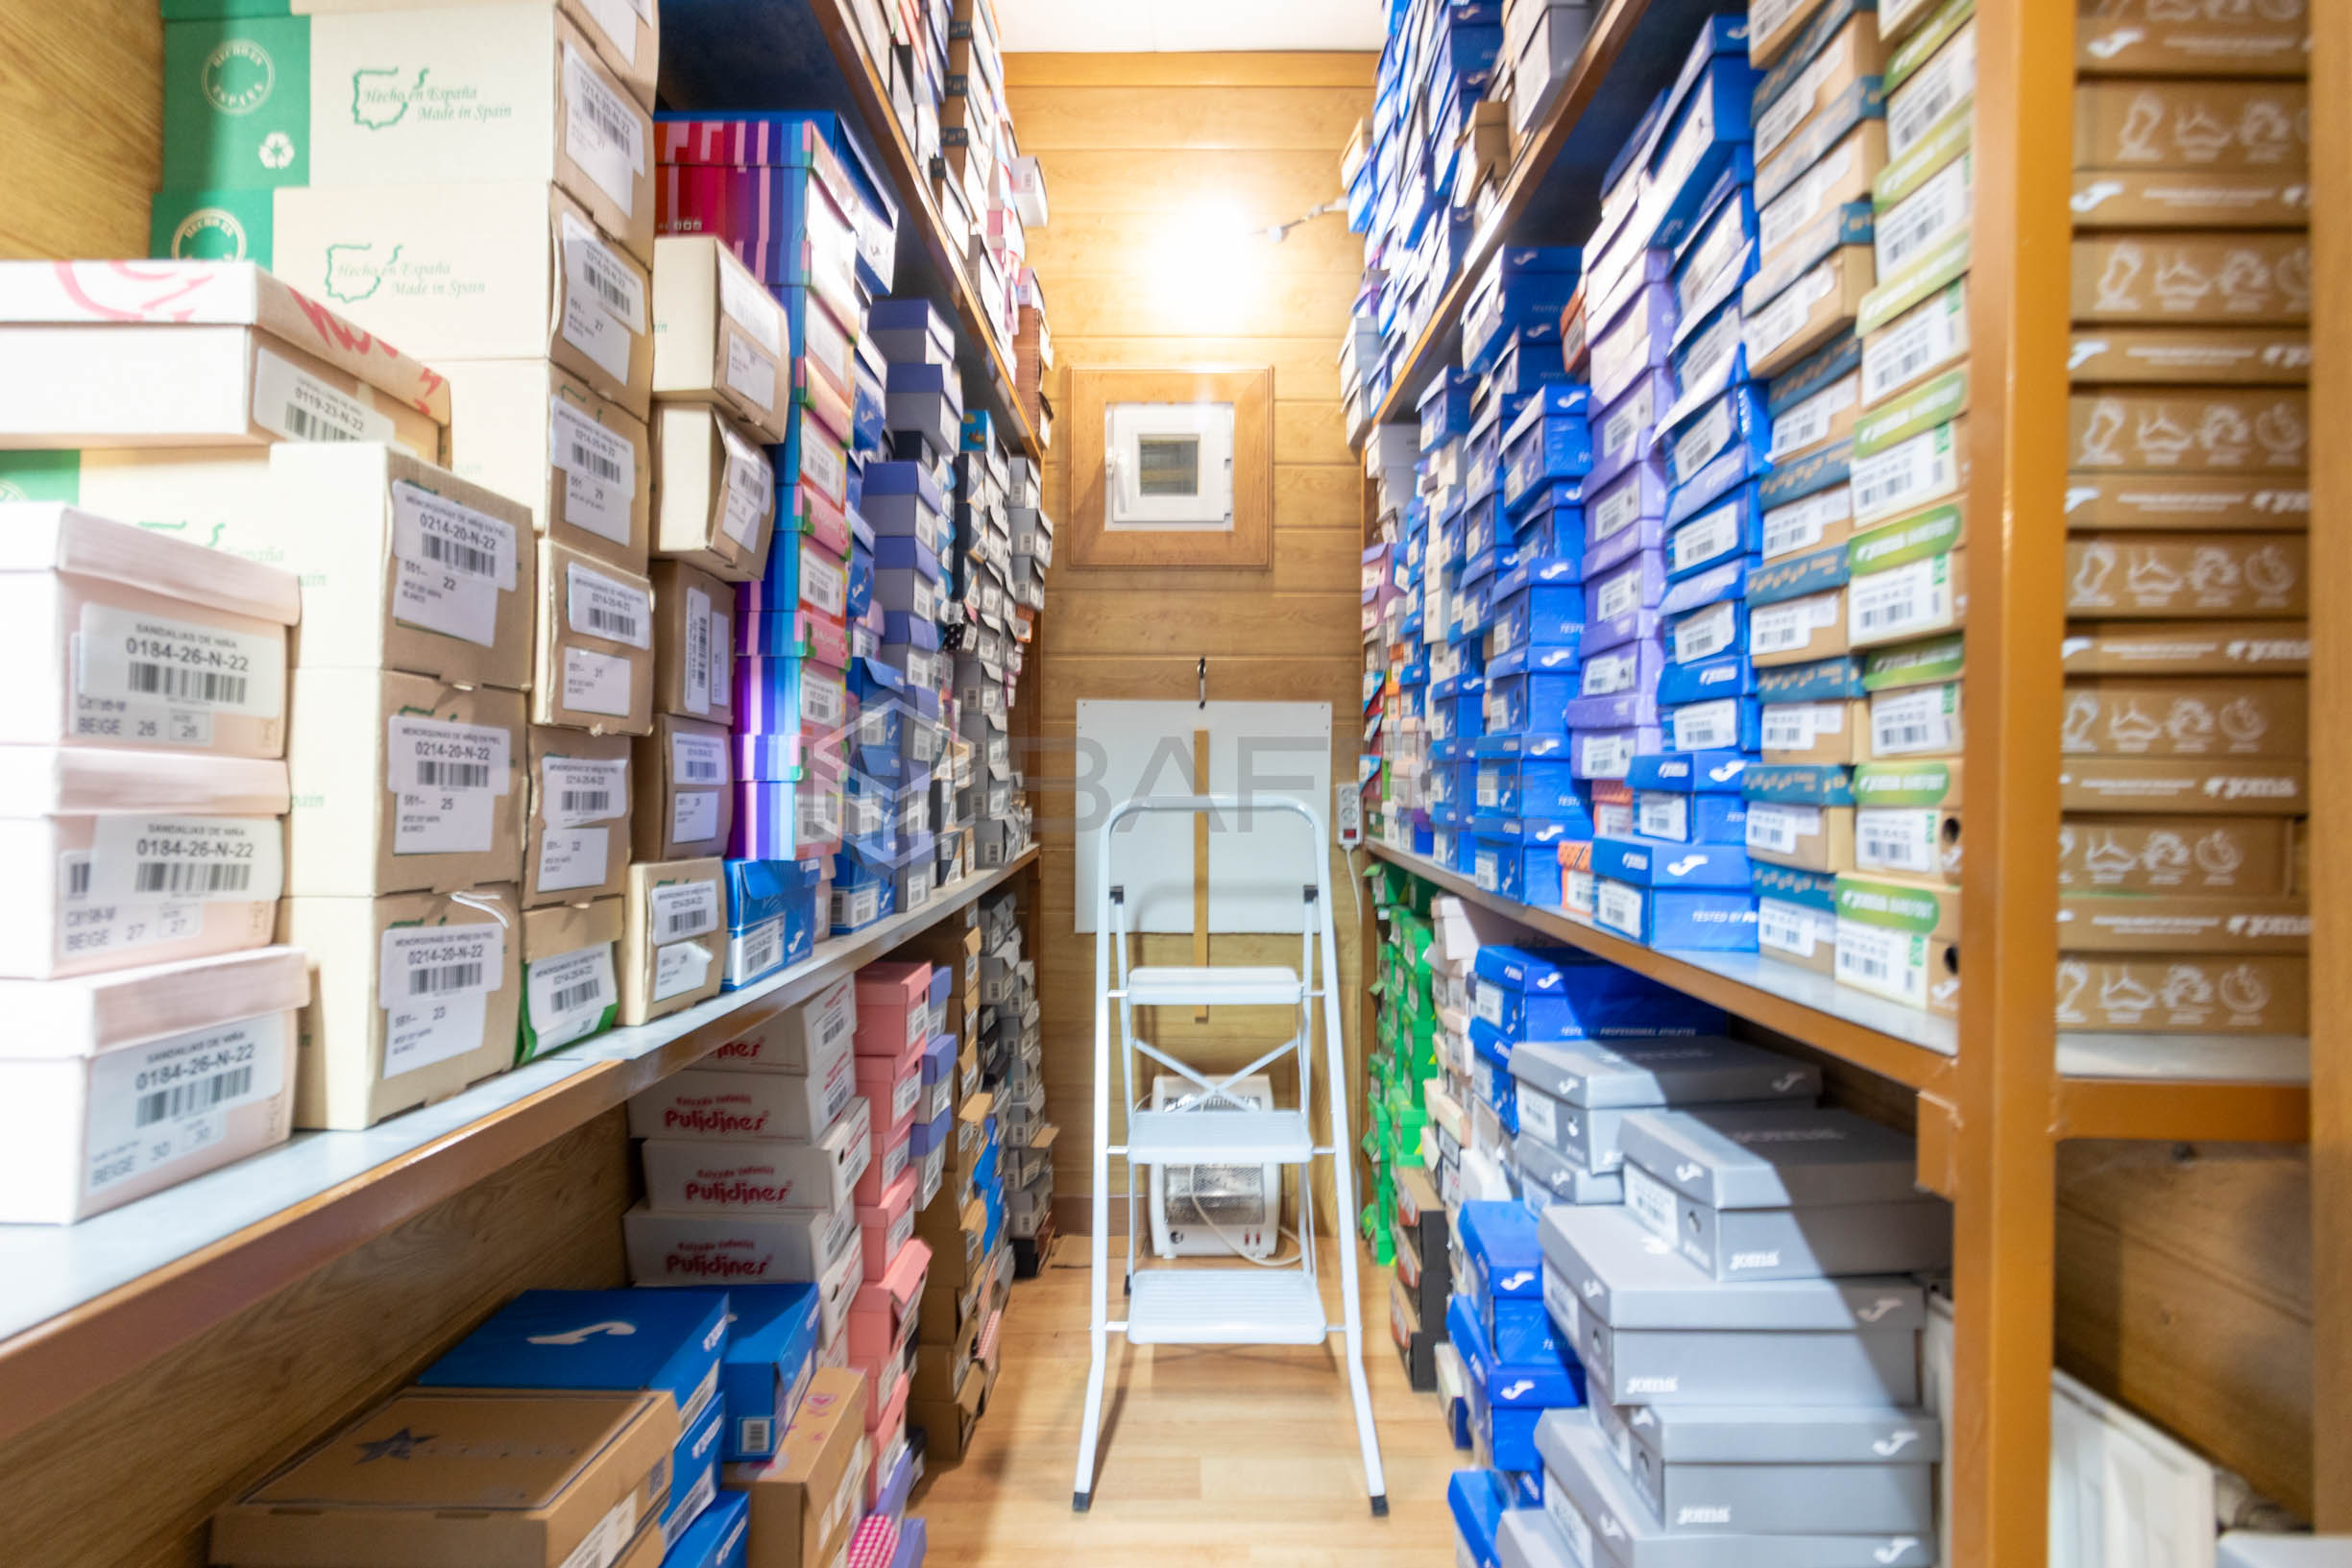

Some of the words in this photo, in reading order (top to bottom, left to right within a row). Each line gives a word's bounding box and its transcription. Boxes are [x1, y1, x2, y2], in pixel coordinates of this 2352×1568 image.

[365, 87, 405, 105] Hecho
[408, 90, 423, 102] en
[428, 85, 478, 105] España
[417, 105, 455, 121] Made
[475, 103, 513, 122] Spain
[443, 576, 456, 591] 22
[126, 637, 249, 672] 0184-26-N-22
[415, 741, 491, 761] 0214-20-N-22
[135, 837, 255, 859] 0184-26-N-22
